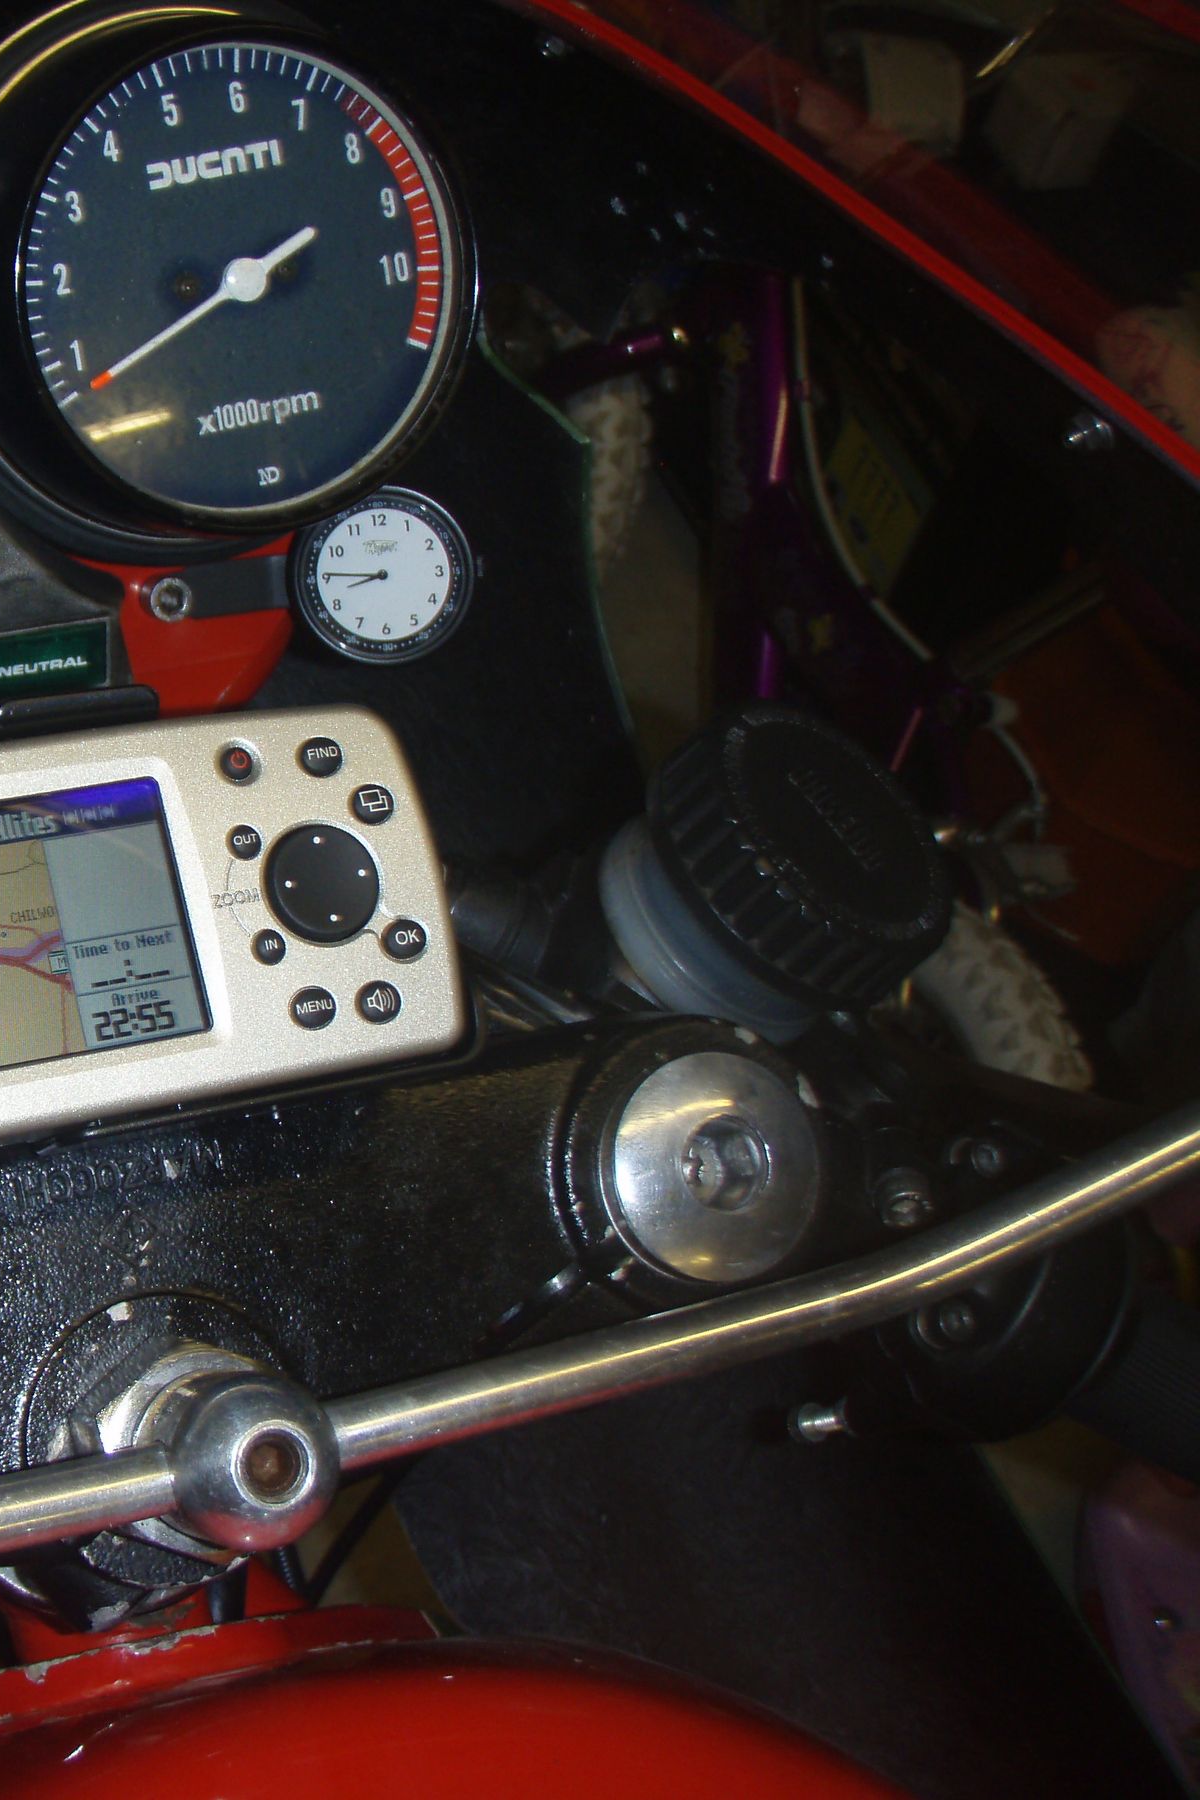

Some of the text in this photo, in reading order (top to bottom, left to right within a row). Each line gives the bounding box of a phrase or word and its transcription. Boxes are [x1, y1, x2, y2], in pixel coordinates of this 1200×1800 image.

[229, 81, 248, 113] 6
[161, 94, 180, 127] 5
[291, 98, 306, 131] 7
[103, 130, 120, 162] 4
[344, 132, 360, 164] 8
[146, 139, 284, 191] DUCATI
[66, 191, 84, 223] 3
[380, 187, 396, 219] 9
[379, 252, 409, 286] 10
[53, 263, 72, 296] 2
[69, 340, 84, 371] 1
[371, 513, 387, 527] 12
[404, 519, 410, 532] 1
[347, 523, 361, 536] 11
[328, 545, 344, 558] 10
[424, 538, 434, 551] 2
[322, 573, 331, 584] 9
[435, 565, 444, 577] 3
[333, 598, 342, 611] 8
[427, 593, 437, 605] 4
[355, 616, 364, 629] 7
[410, 614, 419, 626] 5
[382, 623, 391, 635] 6
[307, 746, 338, 761] FIND
[233, 833, 257, 845] OUT
[211, 888, 260, 910] ZOOM
[72, 930, 173, 960] Time to Next
[265, 938, 278, 951] IN
[396, 929, 419, 945] OK
[111, 988, 160, 1007] Arrive
[295, 999, 334, 1015] MENU
[92, 1000, 176, 1042] 22:55
